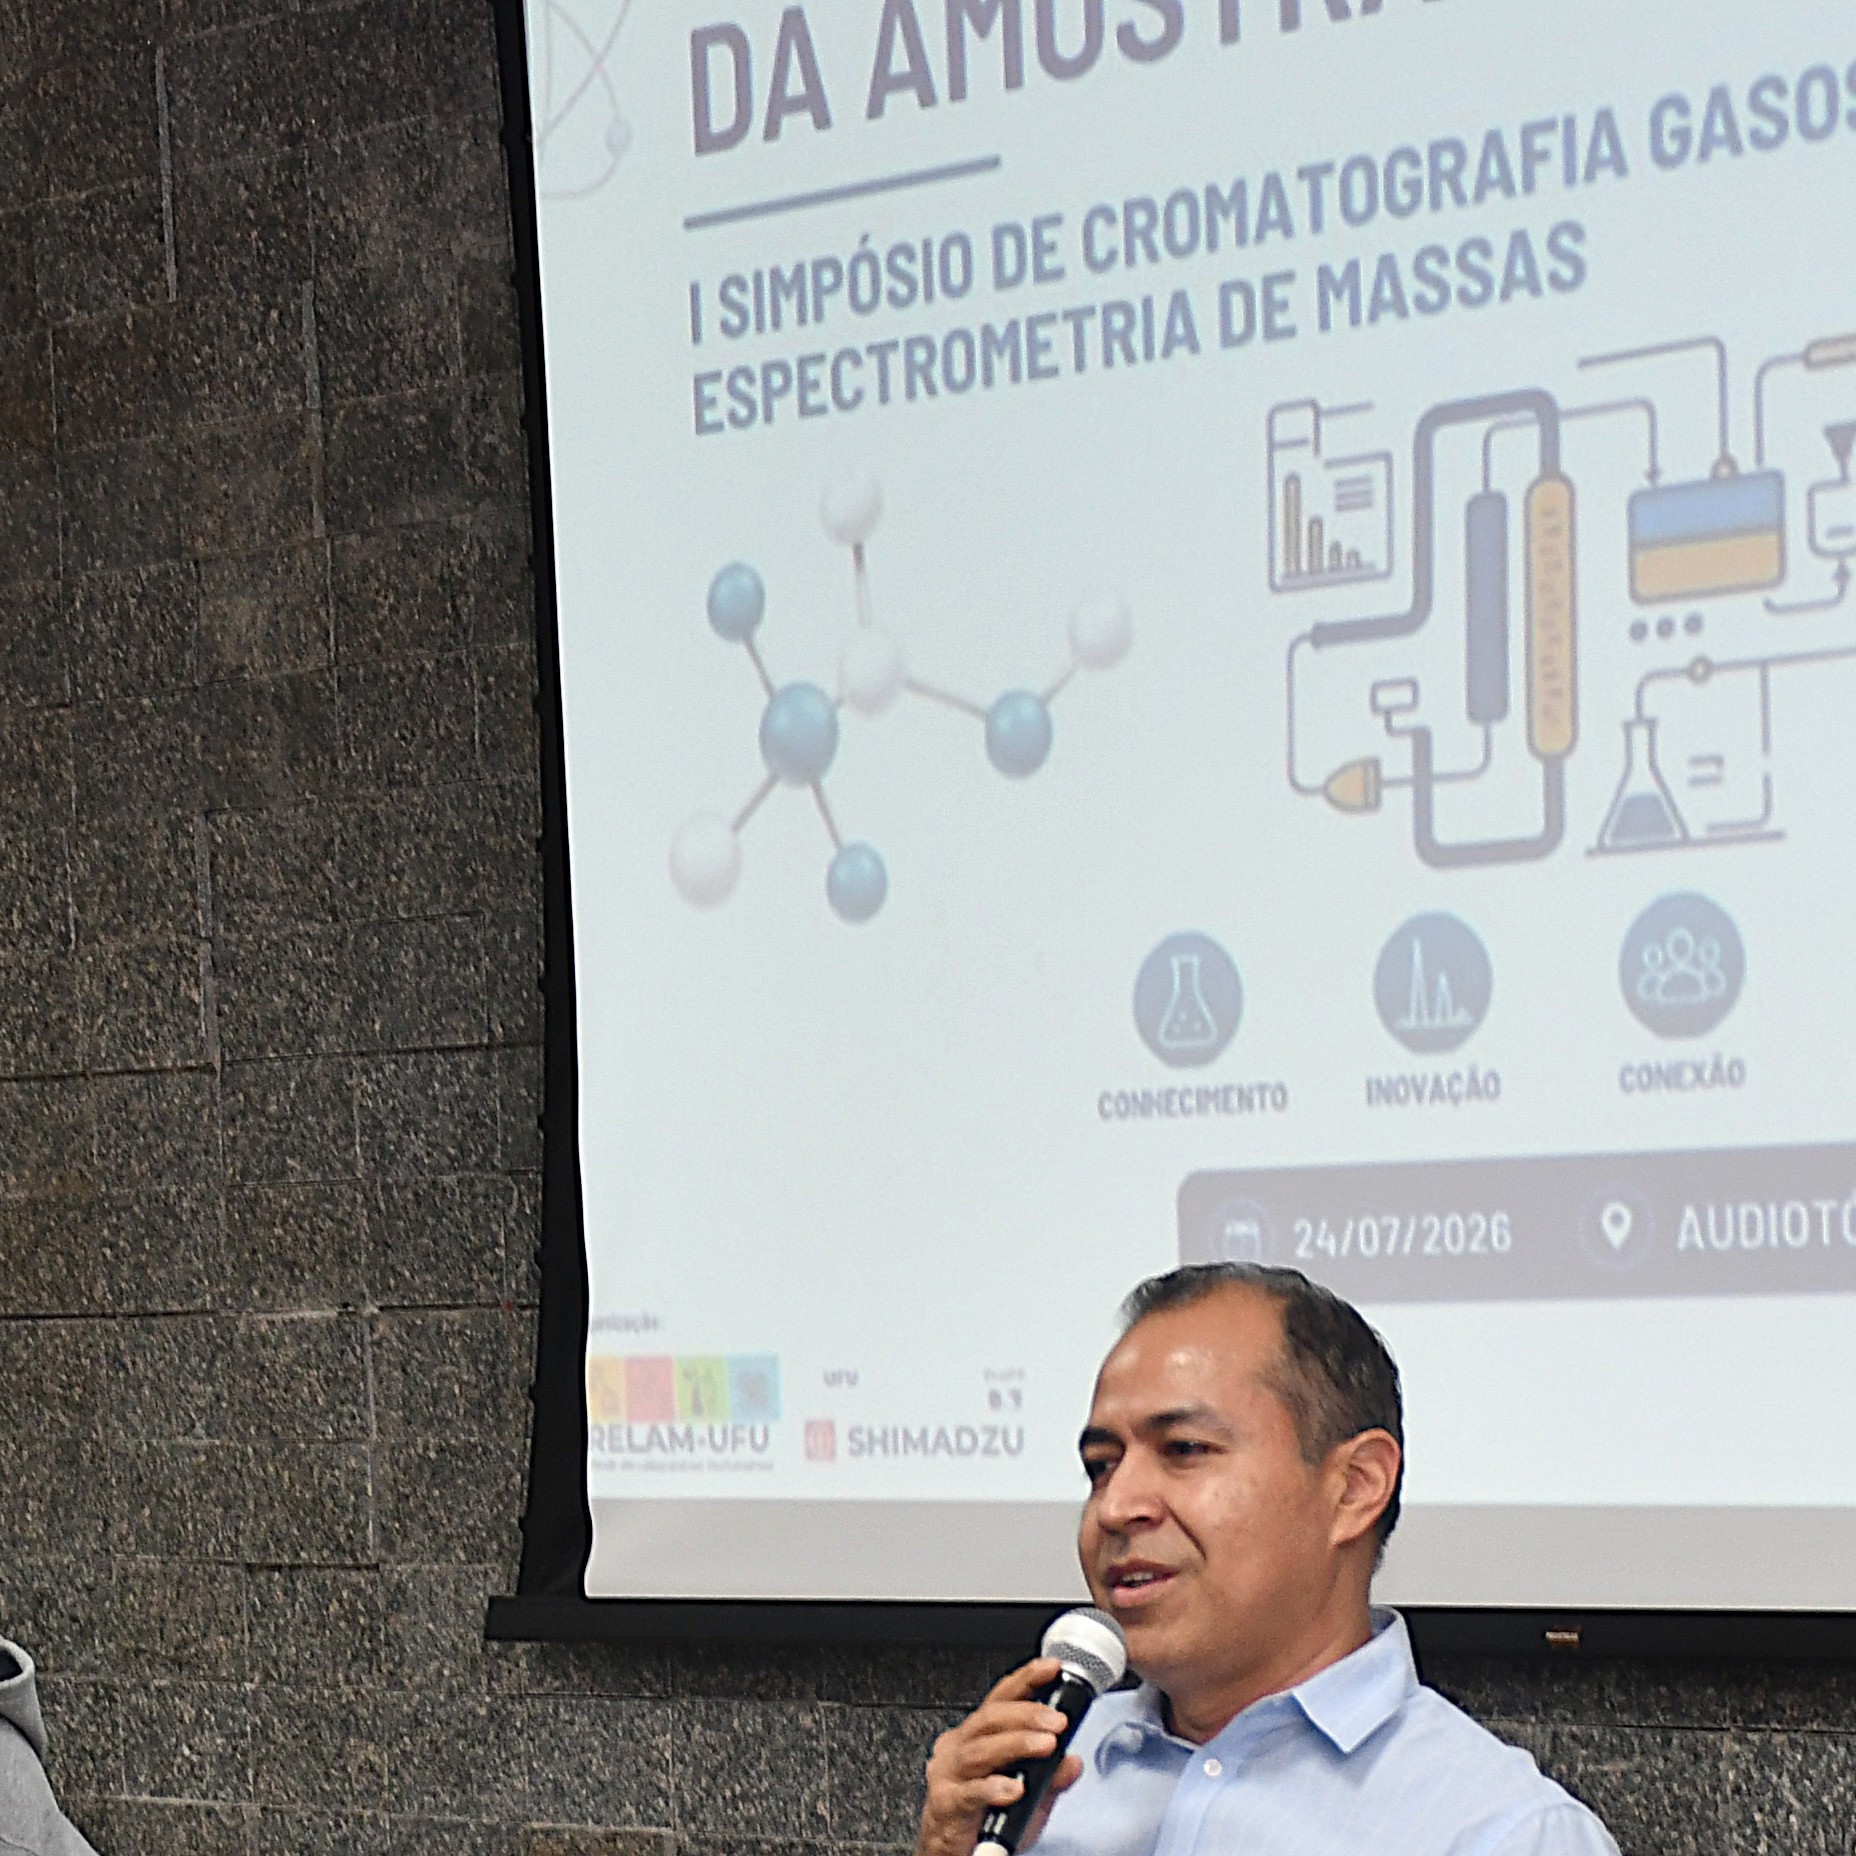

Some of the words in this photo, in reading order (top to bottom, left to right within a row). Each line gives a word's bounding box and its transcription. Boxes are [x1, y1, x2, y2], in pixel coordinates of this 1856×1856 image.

[689, 4, 833, 157] DA
[689, 281, 703, 347] I
[718, 232, 973, 340] SIMPÓSIO
[991, 213, 1066, 292] DE
[1081, 106, 1629, 274] CROMATOGRAFIA
[693, 289, 1202, 436] ESPECTROMETRIA
[1217, 269, 1298, 350] DE
[1316, 219, 1588, 334] MASSAS
[1366, 1063, 1502, 1109] INOVAÇÃO
[1618, 1050, 1746, 1095] CONEXÃO
[1097, 1082, 1289, 1122] CONHECIMENTO
[1293, 1210, 1513, 1260] 24/07/2026
[847, 1425, 1025, 1458] SHIMADZU
